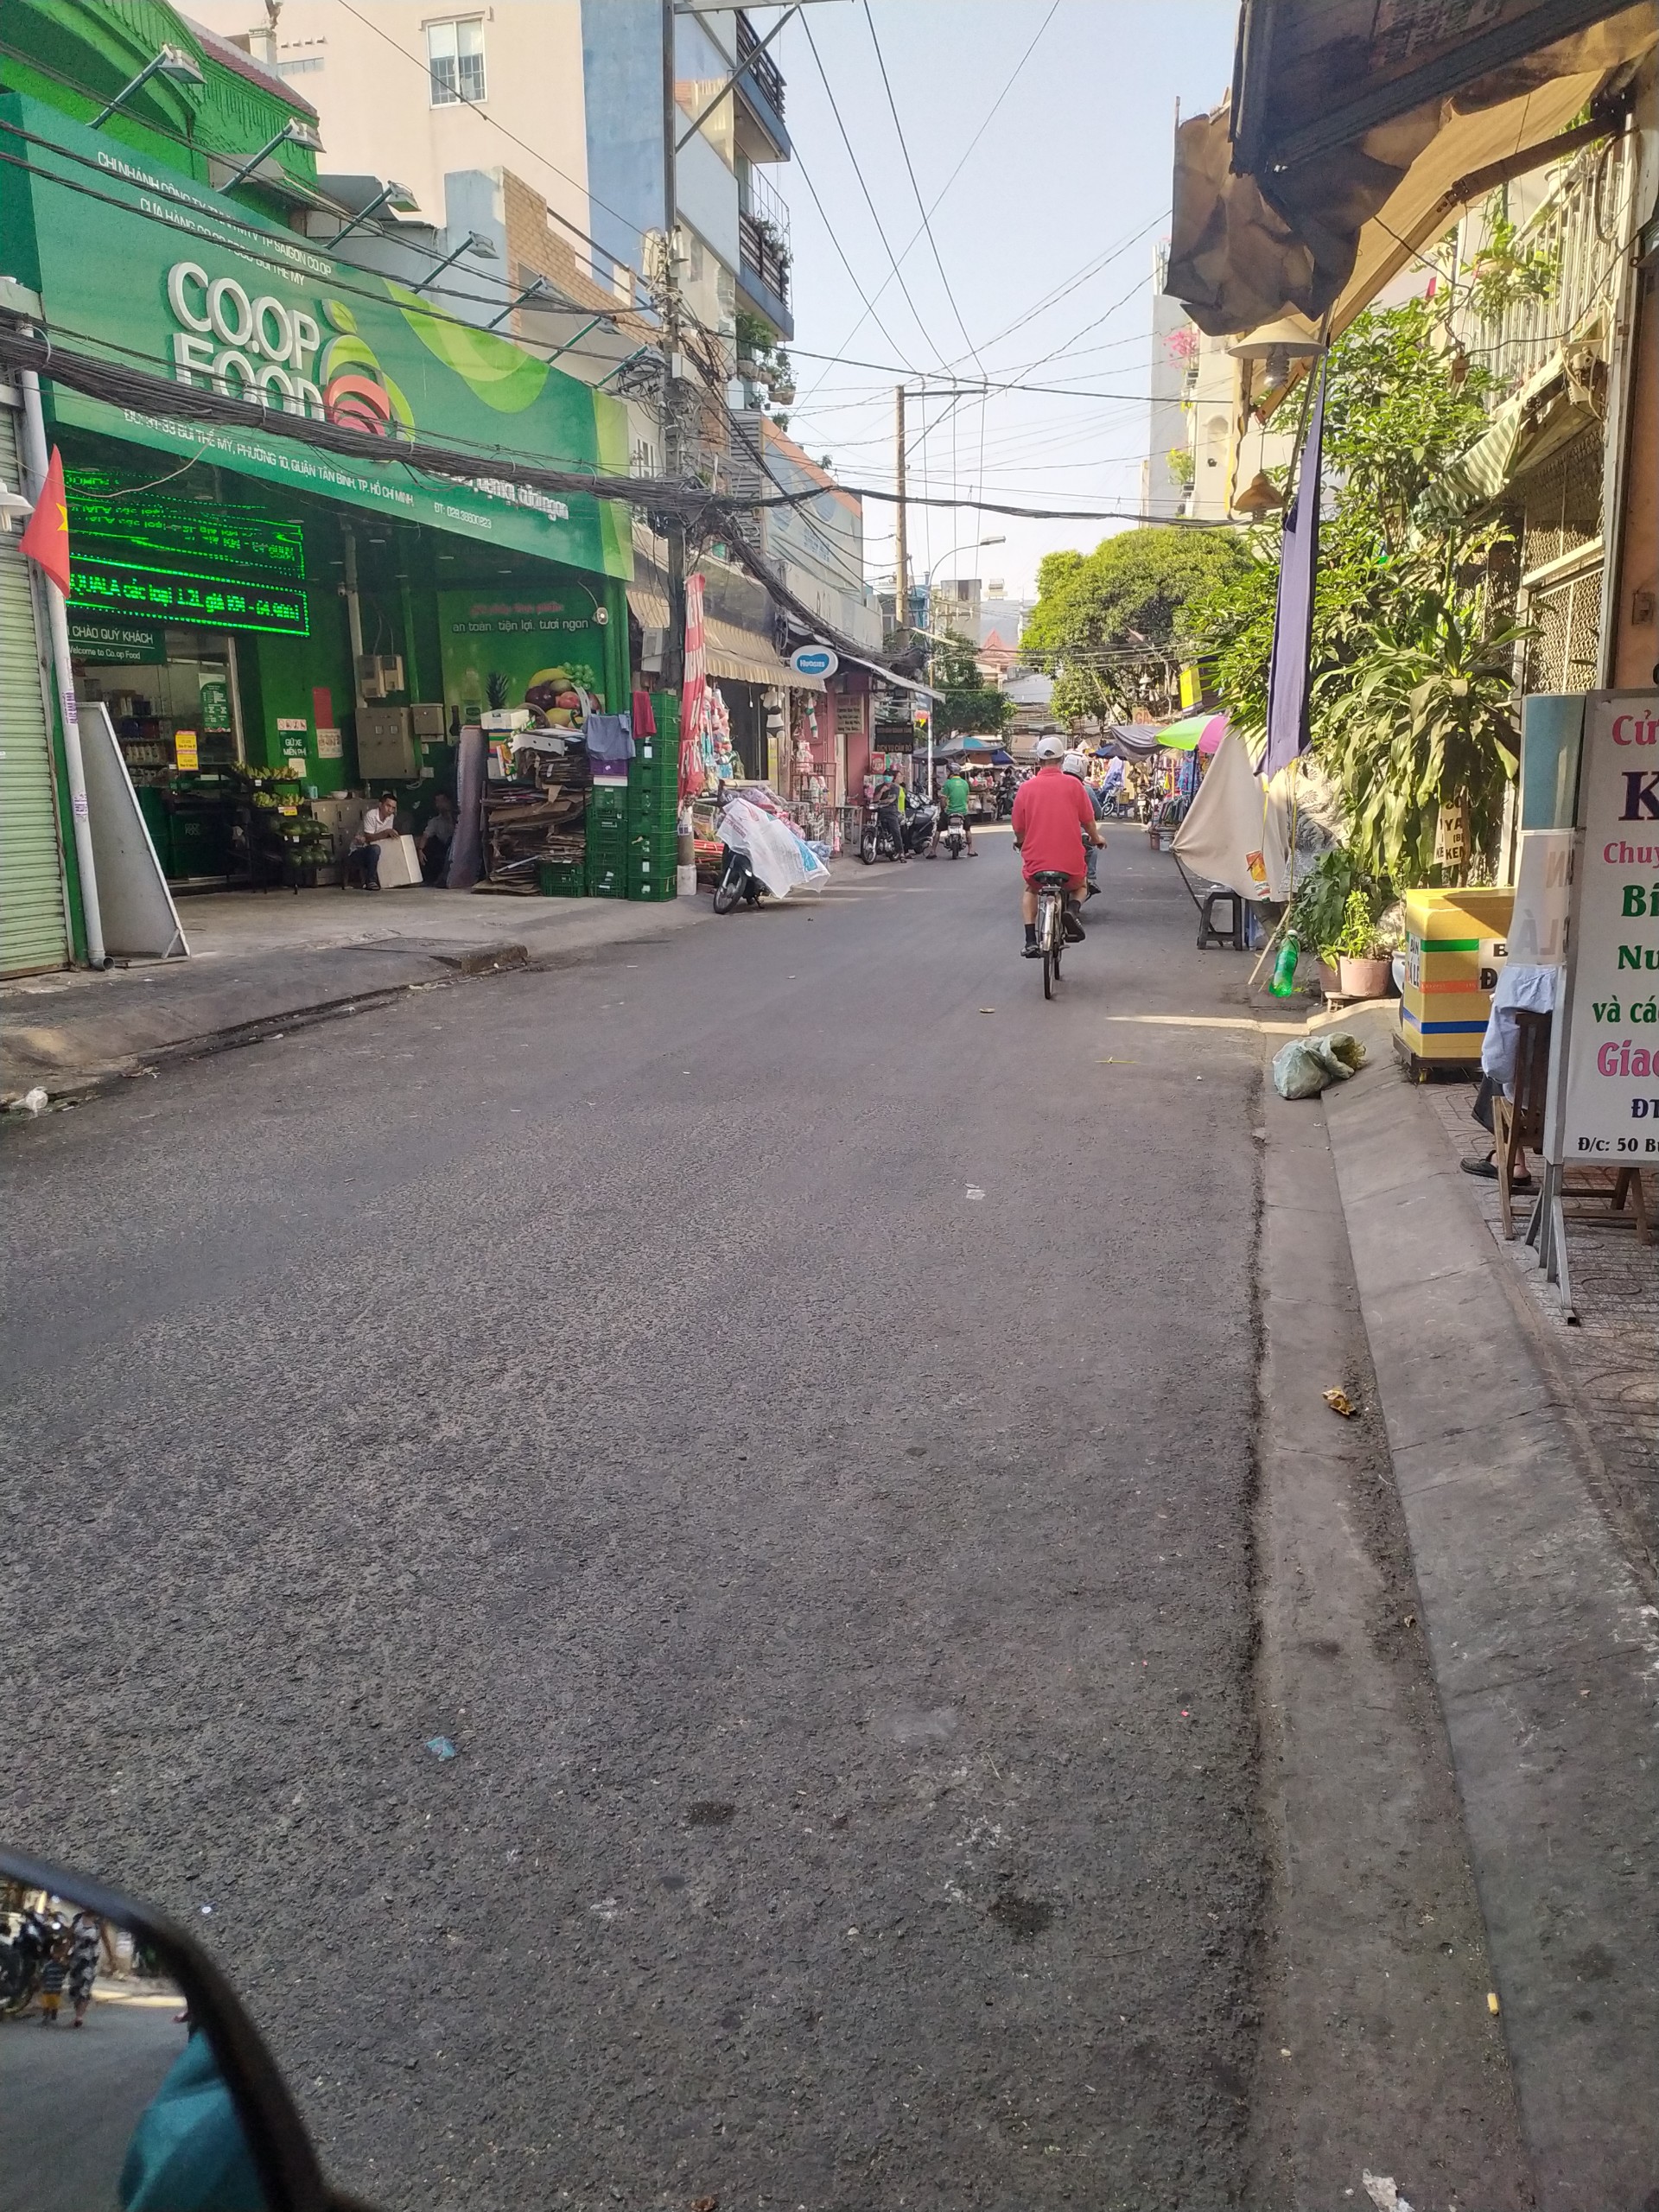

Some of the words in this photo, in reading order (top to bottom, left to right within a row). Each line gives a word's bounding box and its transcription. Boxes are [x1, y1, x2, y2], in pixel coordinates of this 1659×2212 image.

[98, 151, 118, 170] CHI
[168, 262, 321, 370] CO.OP
[72, 624, 99, 639] CHÀO
[100, 627, 121, 641] QUÝ
[122, 630, 154, 645] KHÁCH
[453, 623, 466, 632] an
[563, 620, 588, 632] ngon
[97, 648, 105, 657] to
[125, 650, 141, 660] Food
[1592, 995, 1621, 1023] và
[1578, 1137, 1611, 1153] Đ/c:
[1617, 1137, 1639, 1152] 50
